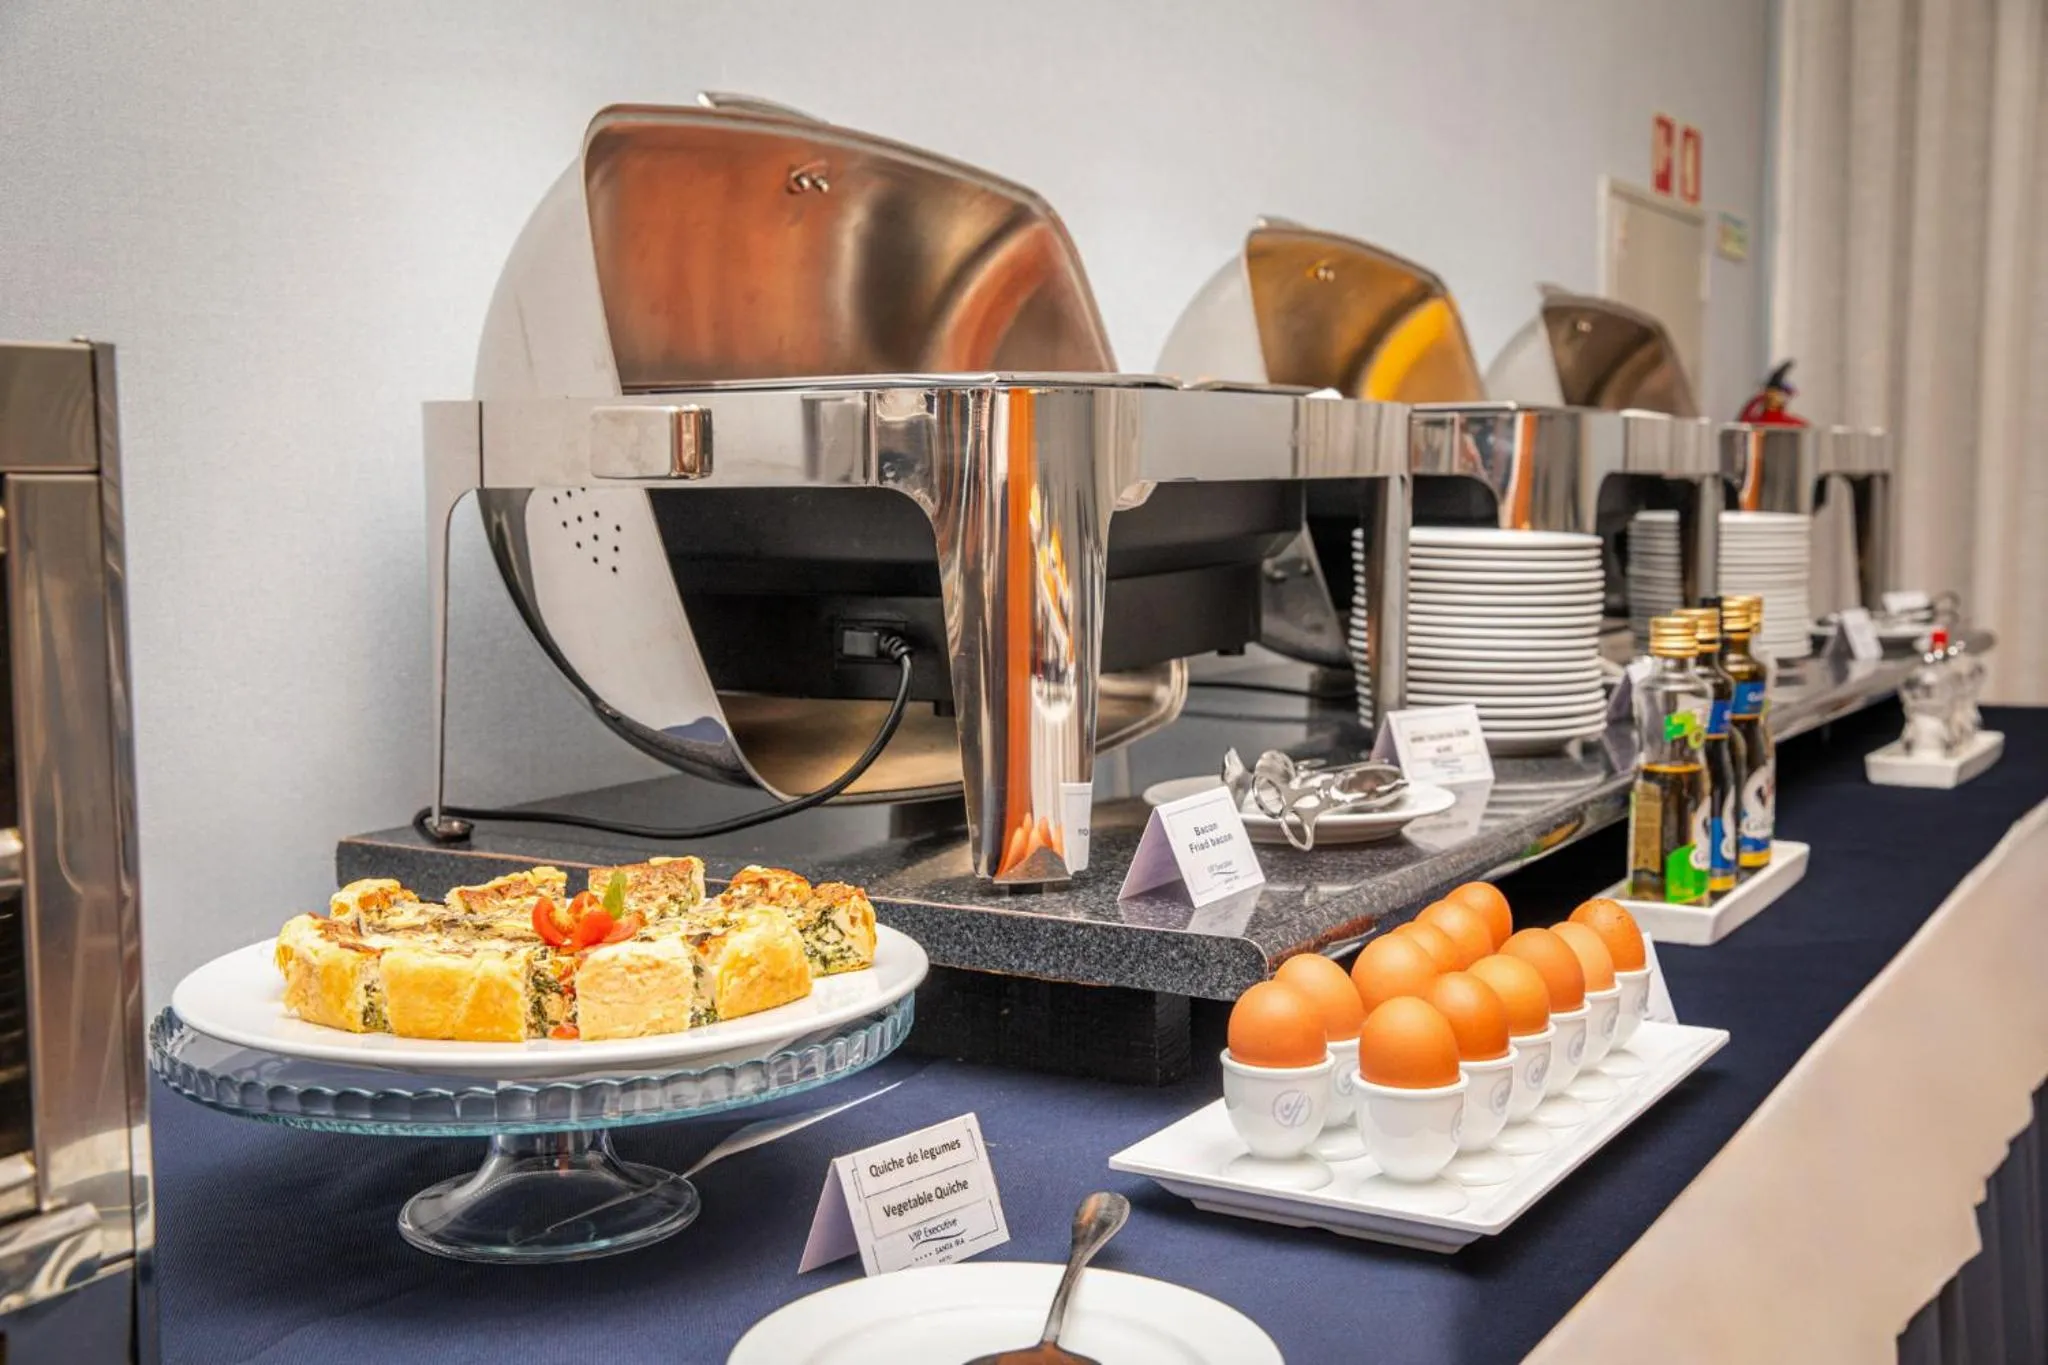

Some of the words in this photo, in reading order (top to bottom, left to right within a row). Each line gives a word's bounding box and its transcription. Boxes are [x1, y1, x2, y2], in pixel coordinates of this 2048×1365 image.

[1193, 823, 1218, 836] Bacon
[1189, 839, 1210, 854] Fried
[1210, 832, 1233, 847] bacon
[869, 1157, 905, 1177] Quiche
[907, 1152, 919, 1165] de
[920, 1139, 961, 1161] legumes
[882, 1190, 933, 1217] Vegetable
[935, 1179, 968, 1200] Quiche
[908, 1230, 922, 1243] VIP
[923, 1218, 957, 1238] Executive
